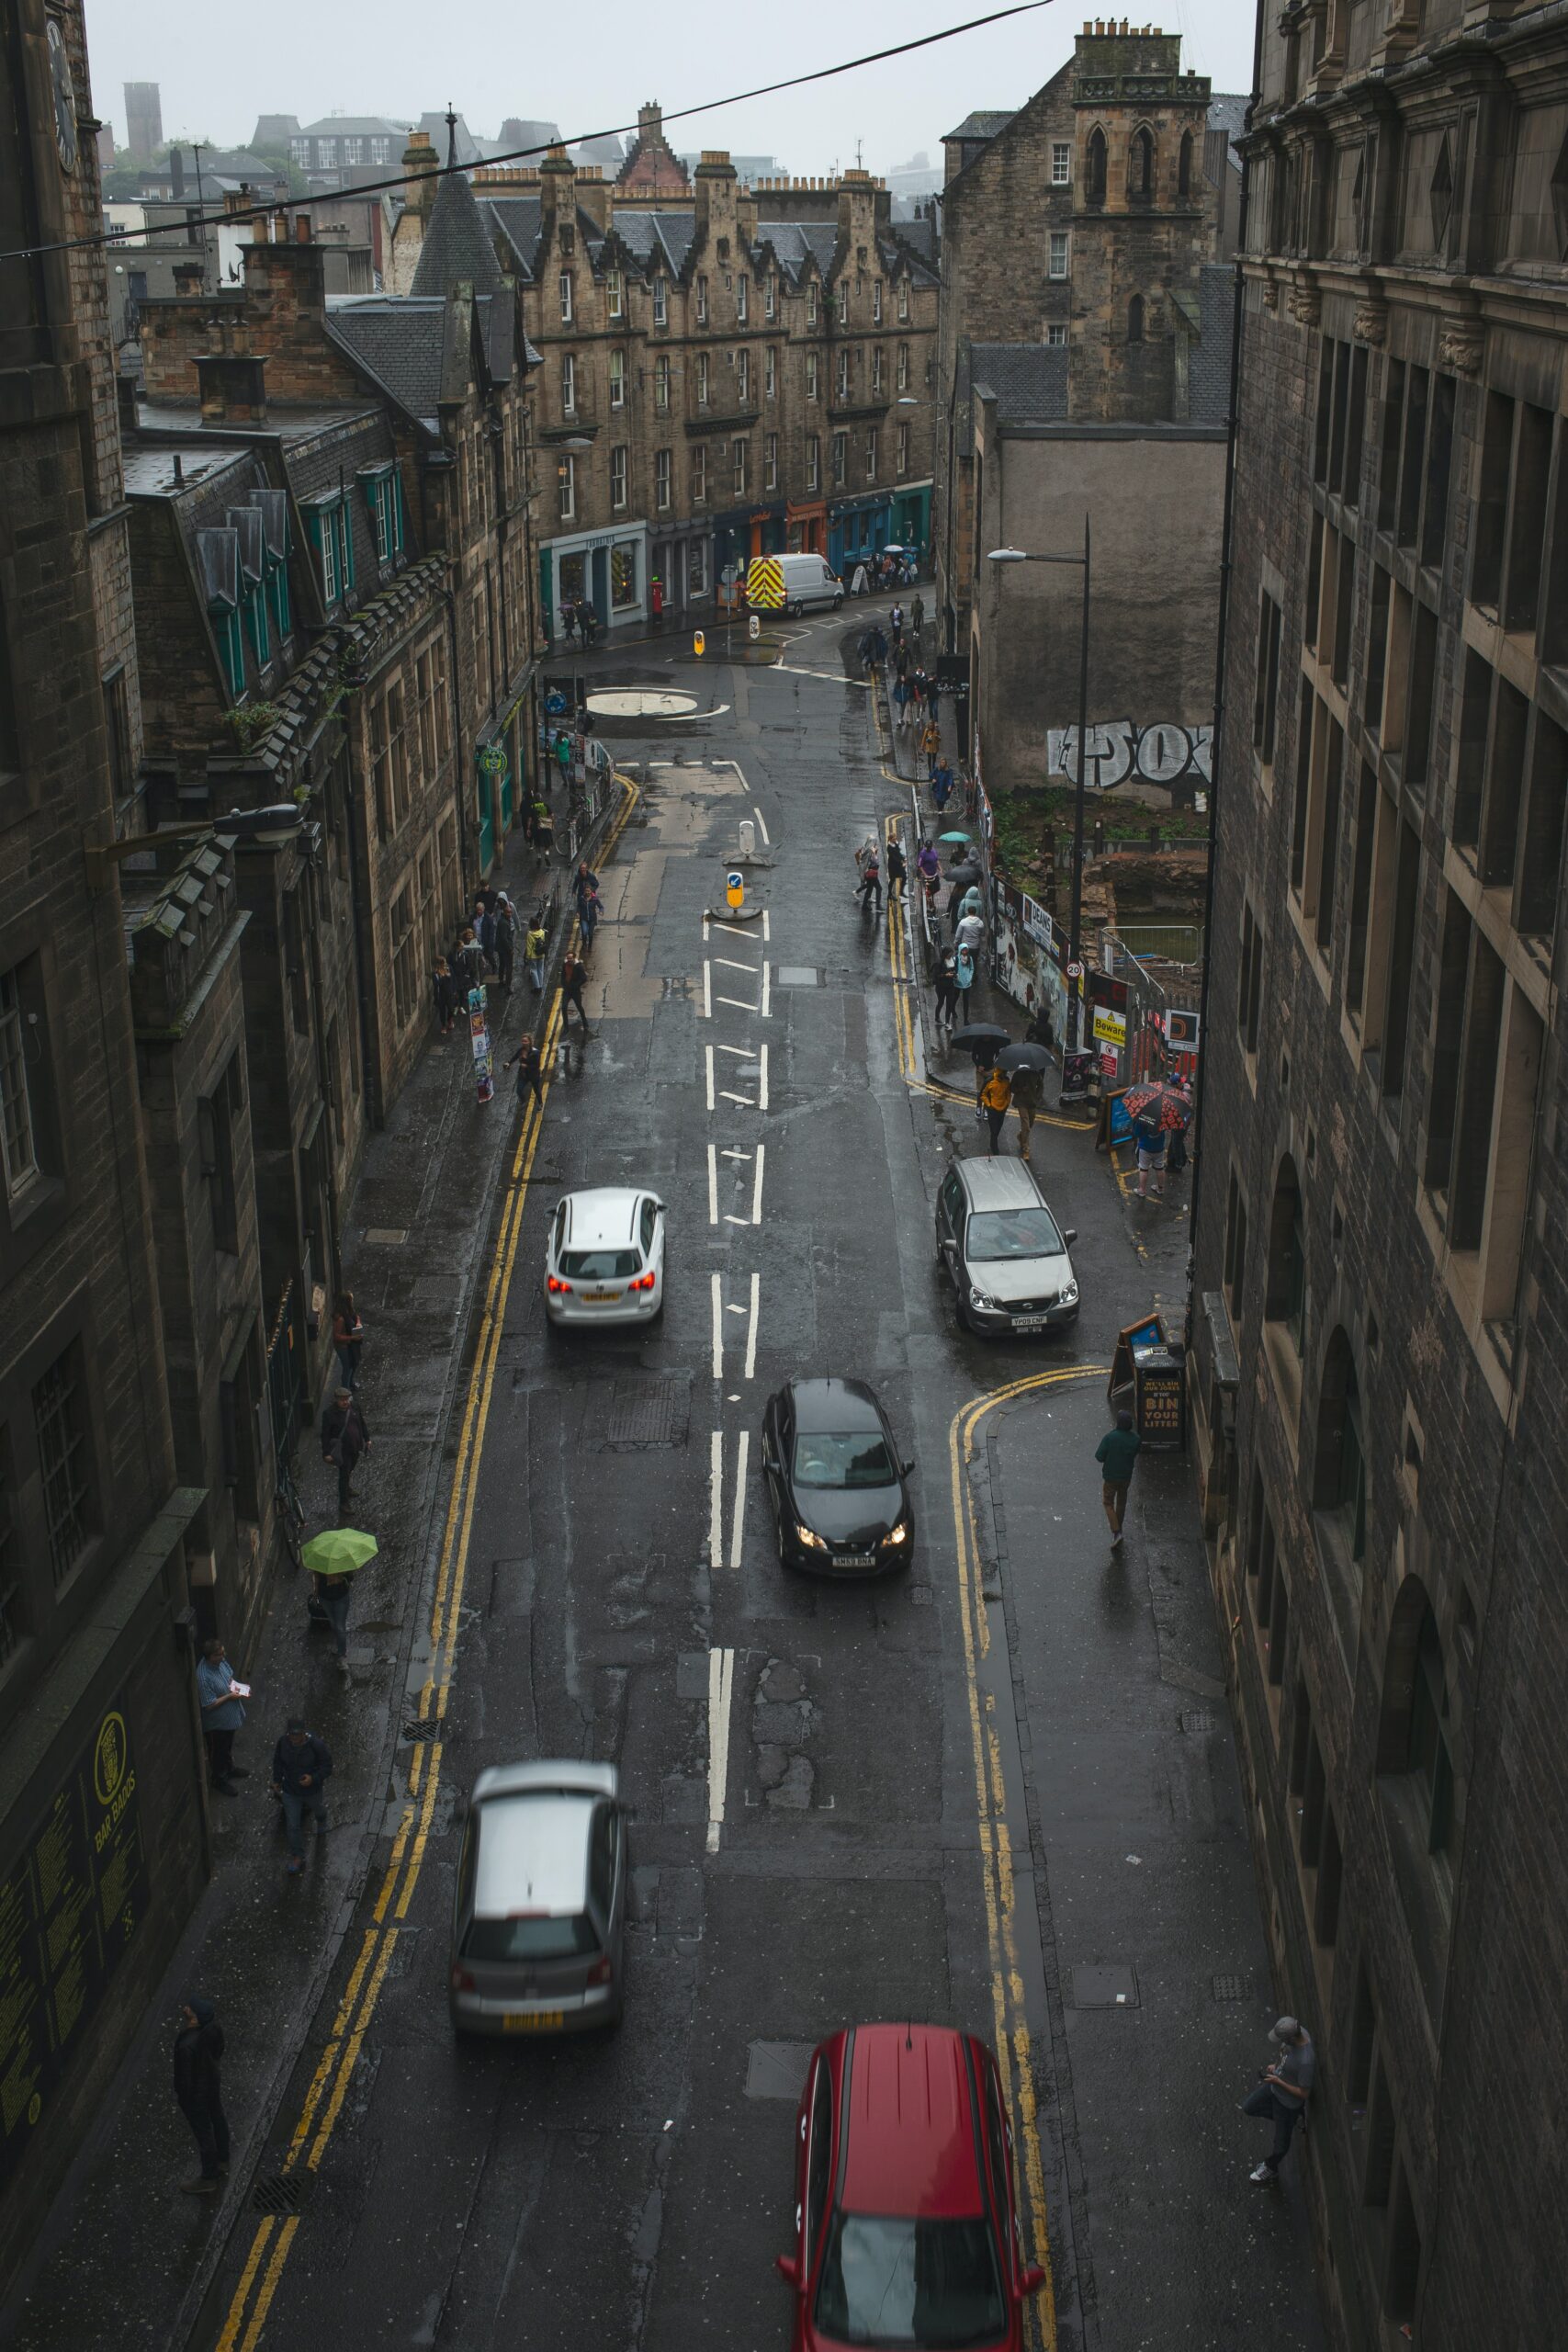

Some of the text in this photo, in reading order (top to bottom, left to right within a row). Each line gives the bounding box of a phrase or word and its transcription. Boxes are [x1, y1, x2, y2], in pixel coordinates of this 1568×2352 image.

[1032, 903, 1051, 933] DEANS
[1095, 1019, 1125, 1037] Beware
[1146, 1398, 1179, 1410] BIN
[96, 1770, 135, 1852] BAR BADOS
